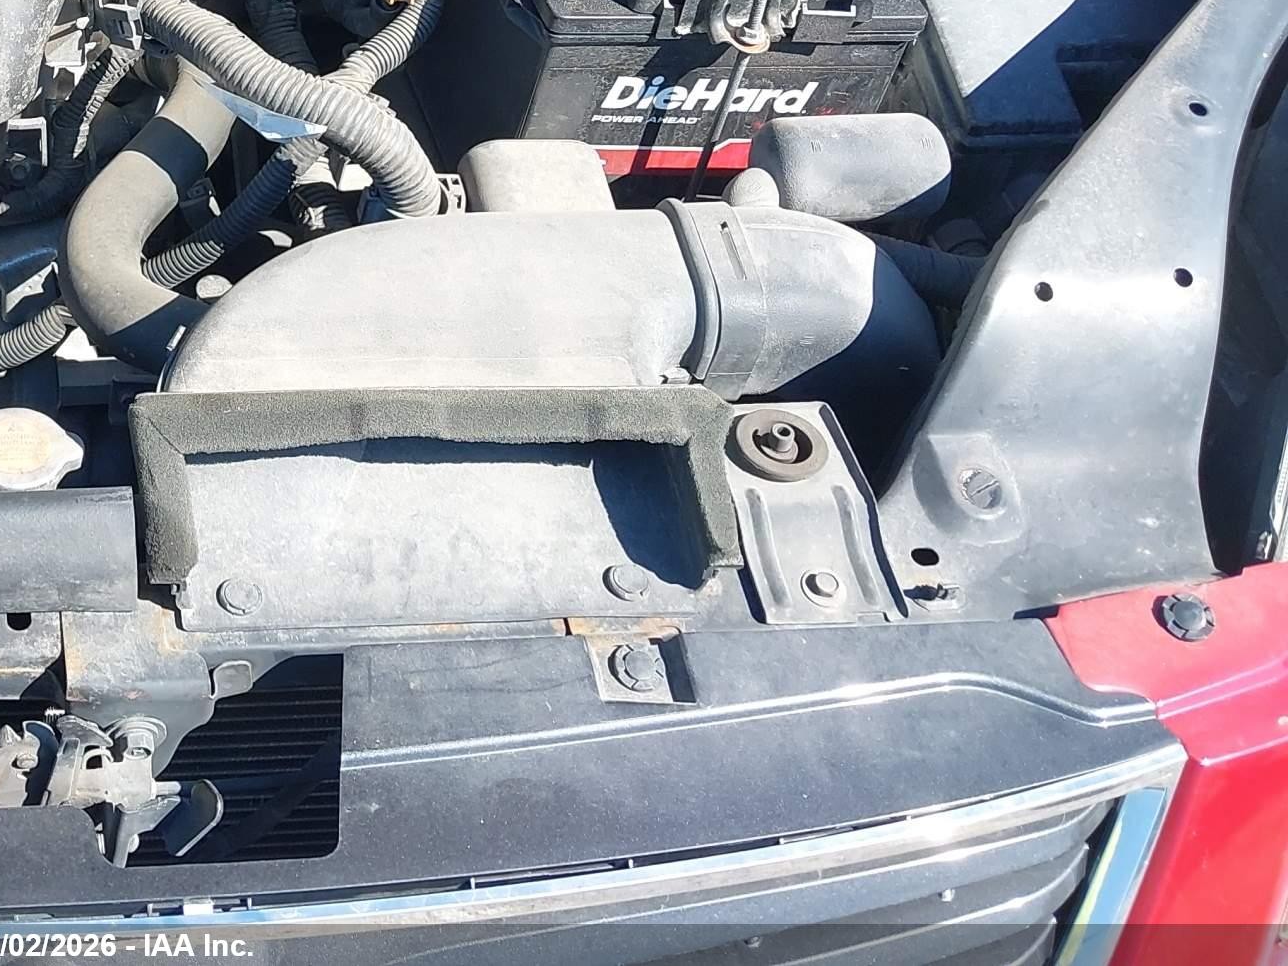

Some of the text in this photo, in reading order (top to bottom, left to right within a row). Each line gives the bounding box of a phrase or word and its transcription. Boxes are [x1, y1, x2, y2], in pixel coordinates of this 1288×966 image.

[600, 75, 819, 114] DieHard
[591, 114, 698, 125] POWER AHEAD
